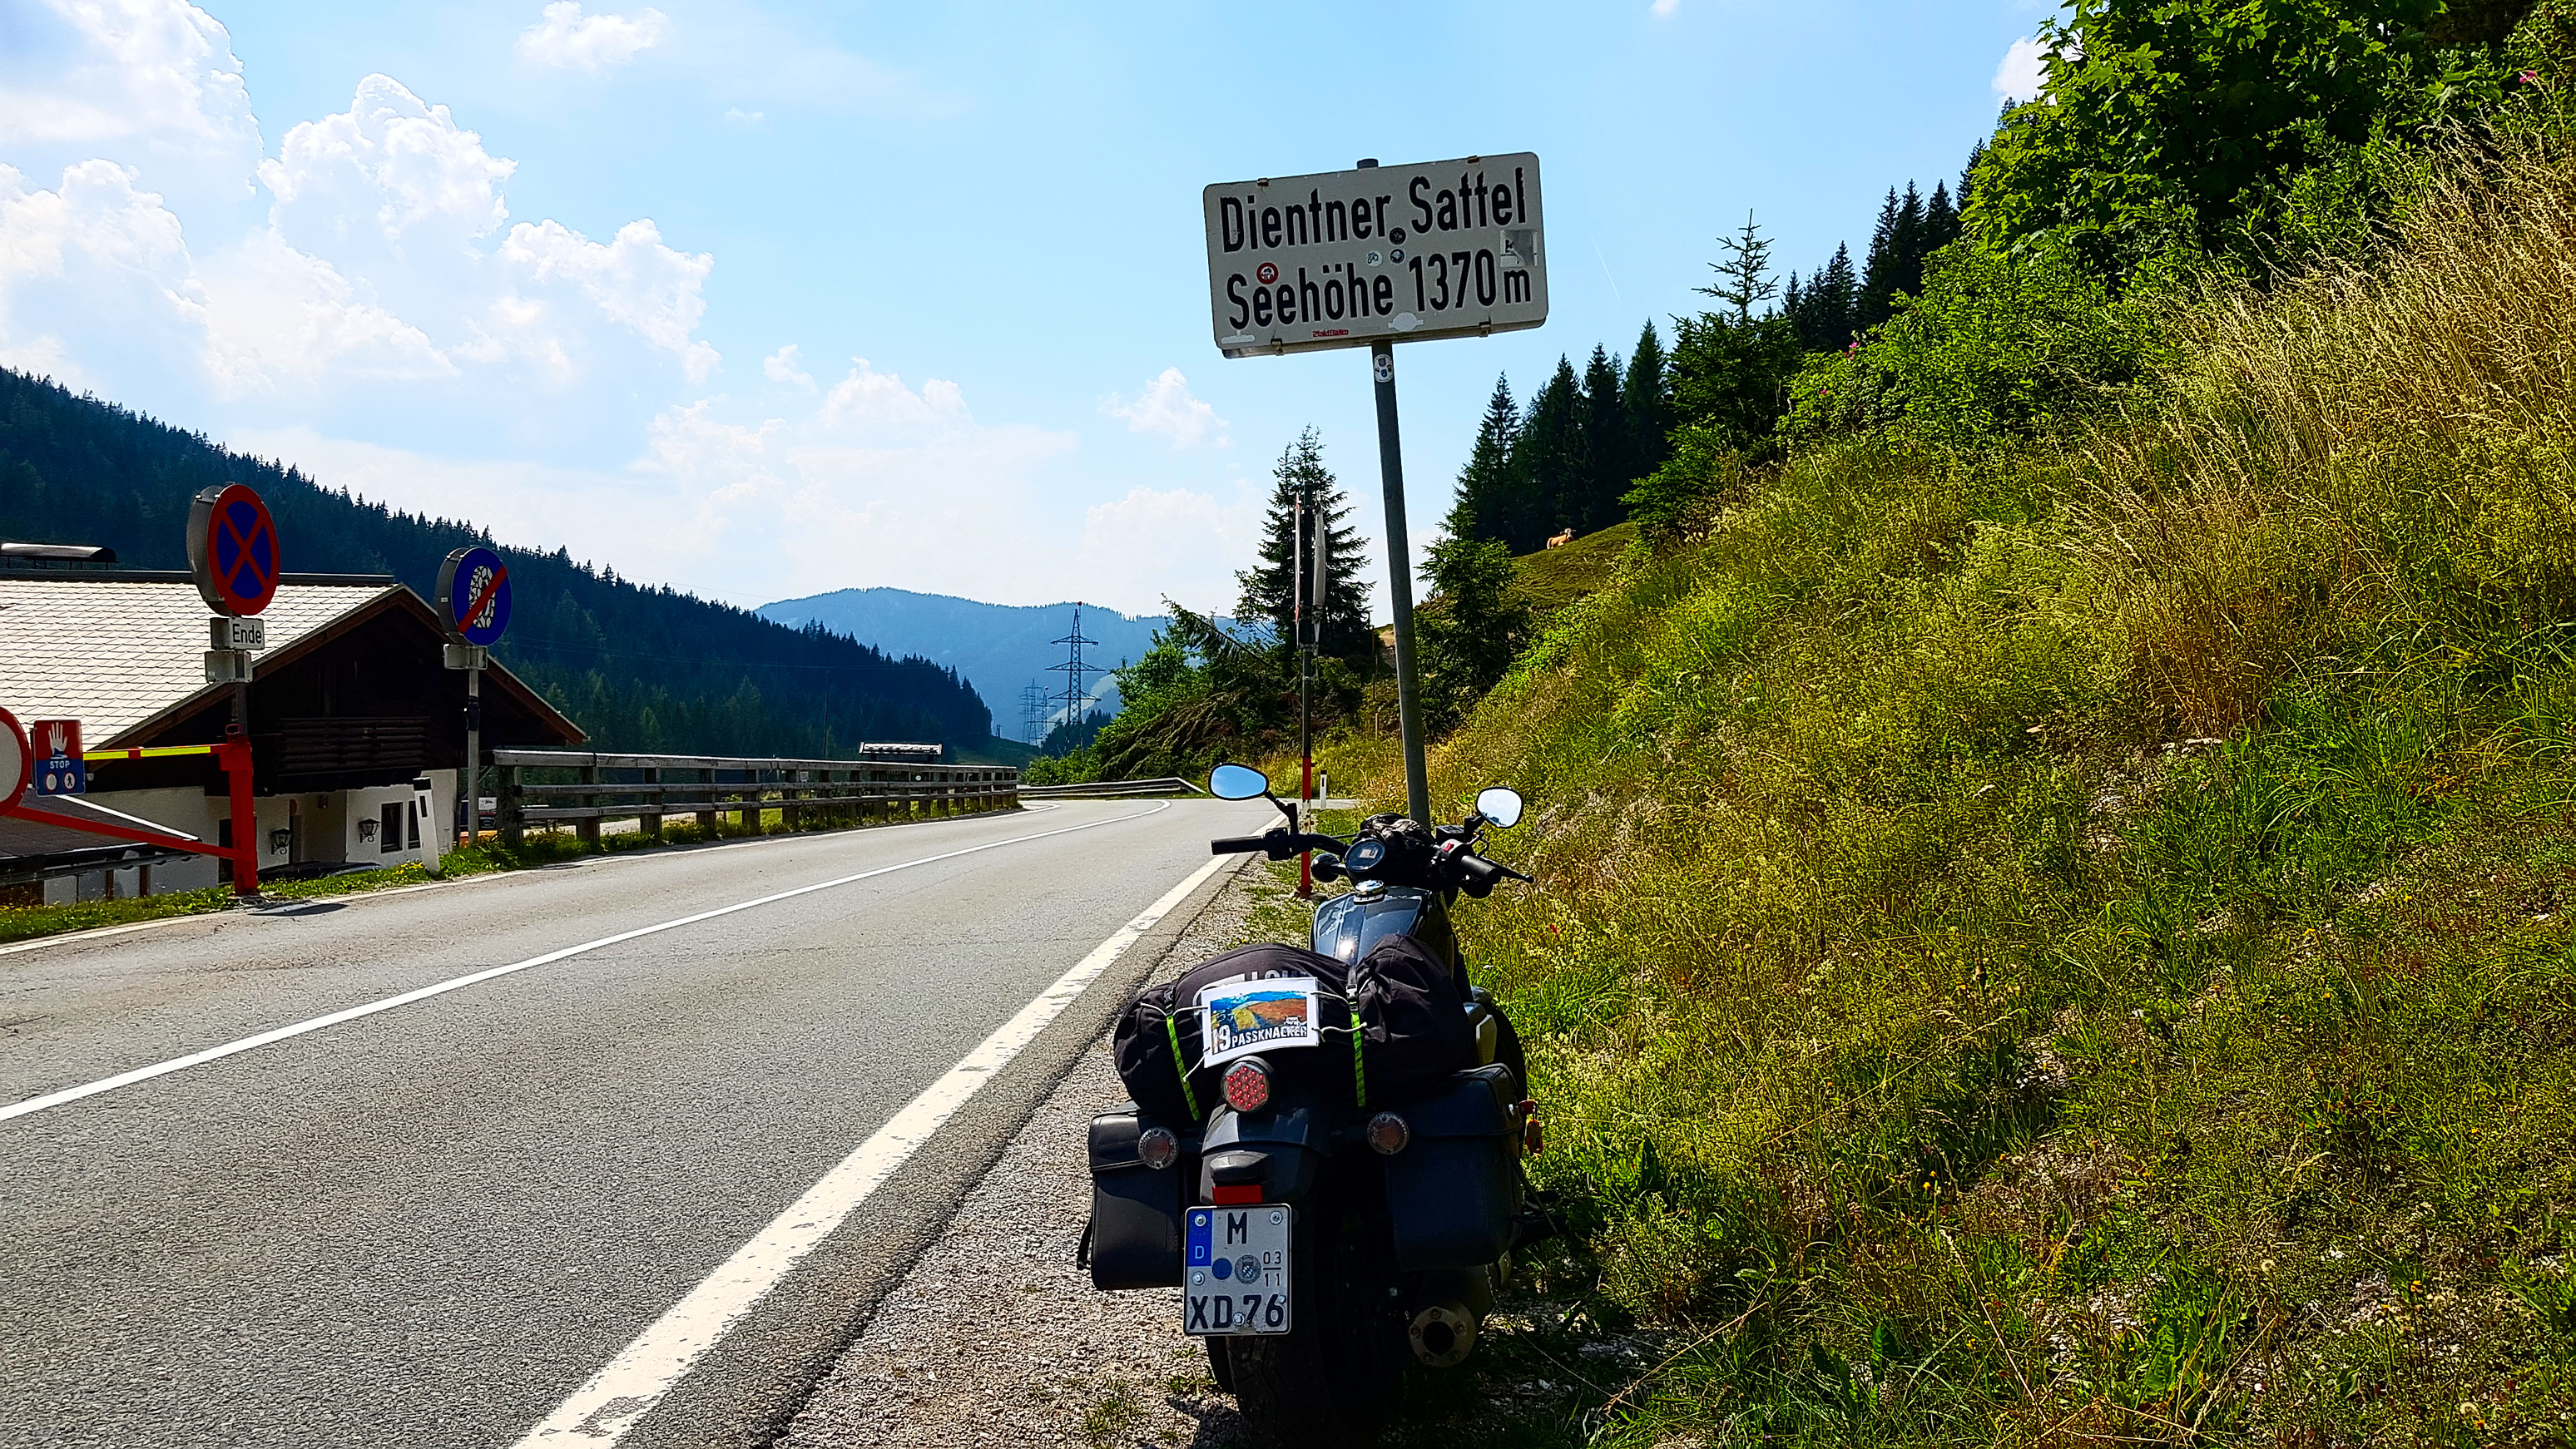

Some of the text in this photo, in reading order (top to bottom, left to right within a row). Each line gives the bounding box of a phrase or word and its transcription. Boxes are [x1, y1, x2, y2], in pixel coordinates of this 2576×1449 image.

[1220, 166, 1527, 253] Dientner Sattel
[1226, 262, 1394, 330] Seehöhe
[232, 623, 262, 645] Ende
[50, 760, 71, 769] STOP
[1211, 1024, 1307, 1054] 19 PASSKNACKER
[1227, 1211, 1247, 1244] M
[1195, 1245, 1205, 1259] D
[1263, 1251, 1282, 1265] 03
[1264, 1273, 1281, 1287] 11
